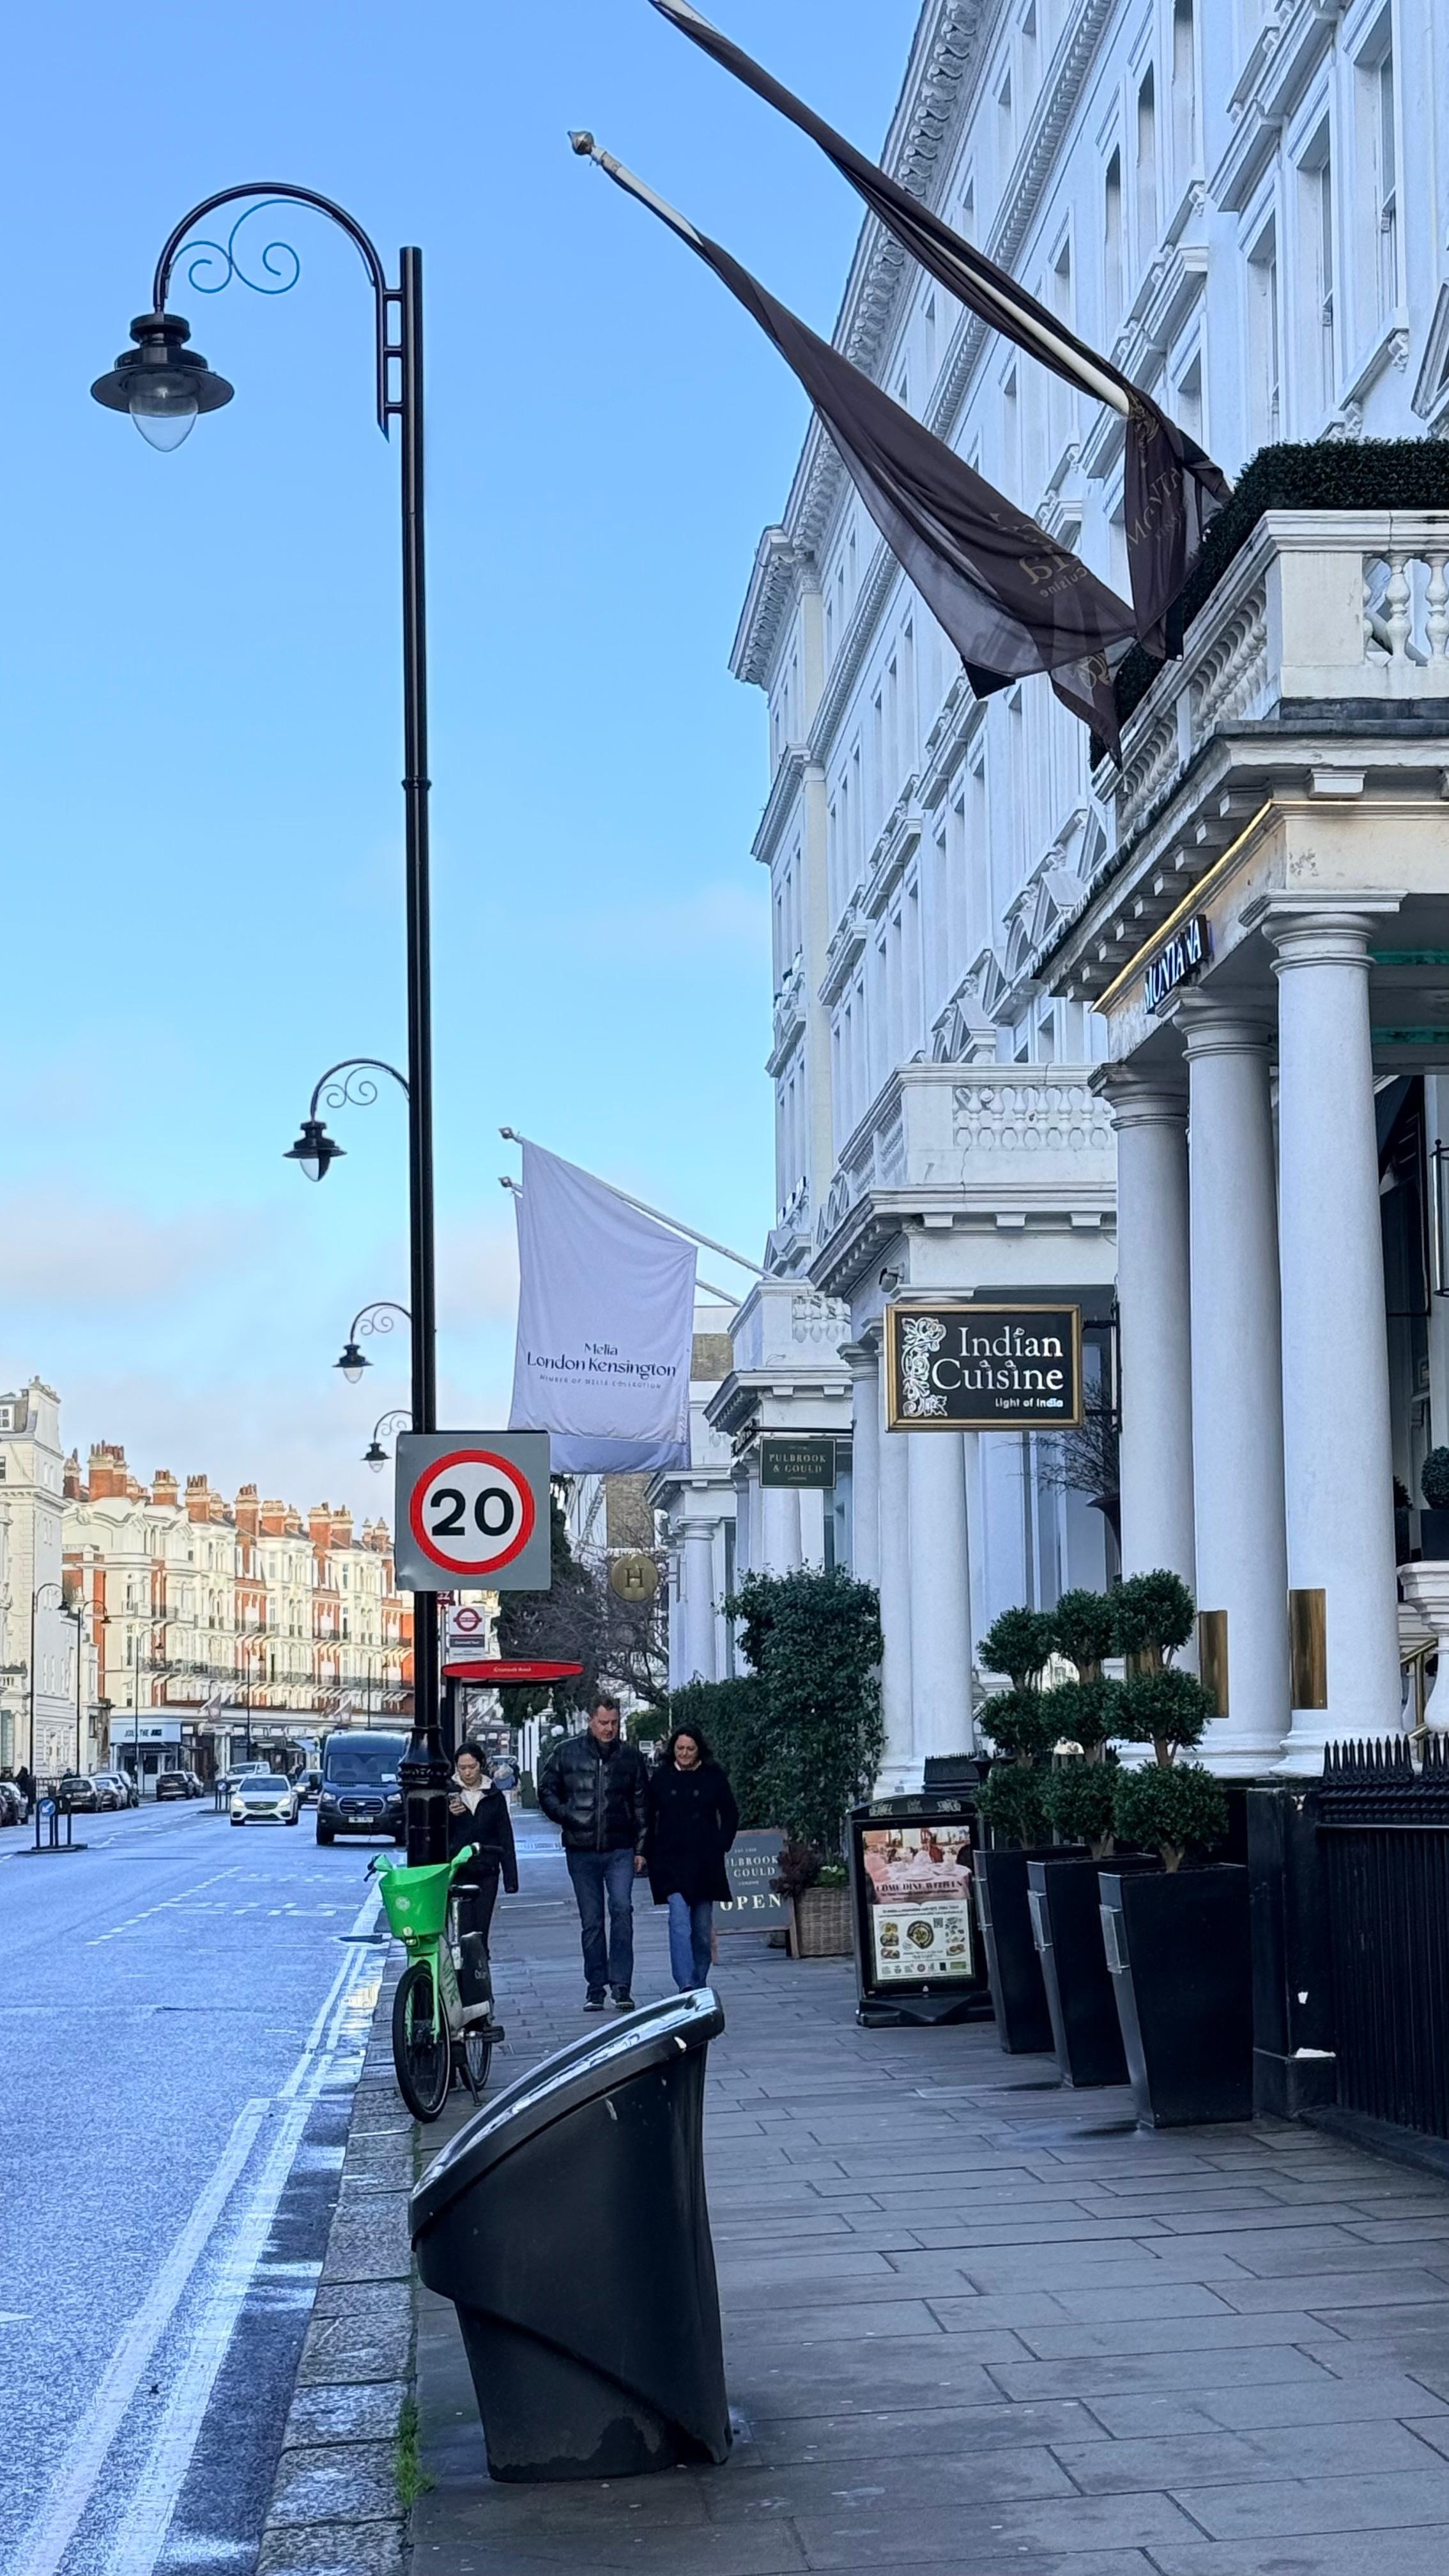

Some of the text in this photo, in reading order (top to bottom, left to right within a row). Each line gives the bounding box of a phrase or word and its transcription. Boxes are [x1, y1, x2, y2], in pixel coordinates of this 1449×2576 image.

[958, 1326, 1064, 1357] Indian
[526, 1351, 677, 1380] London Kensington
[931, 1358, 1064, 1390] Cuisine
[995, 1397, 1064, 1409] Light of India
[769, 1453, 827, 1463] PULBROOK
[772, 1464, 822, 1473] & GOULD
[429, 1487, 515, 1537] 20
[624, 1567, 645, 1588] H
[726, 1855, 779, 1867] LBROOK
[733, 1866, 776, 1878] GOULD
[719, 1893, 782, 1912] OPEN
